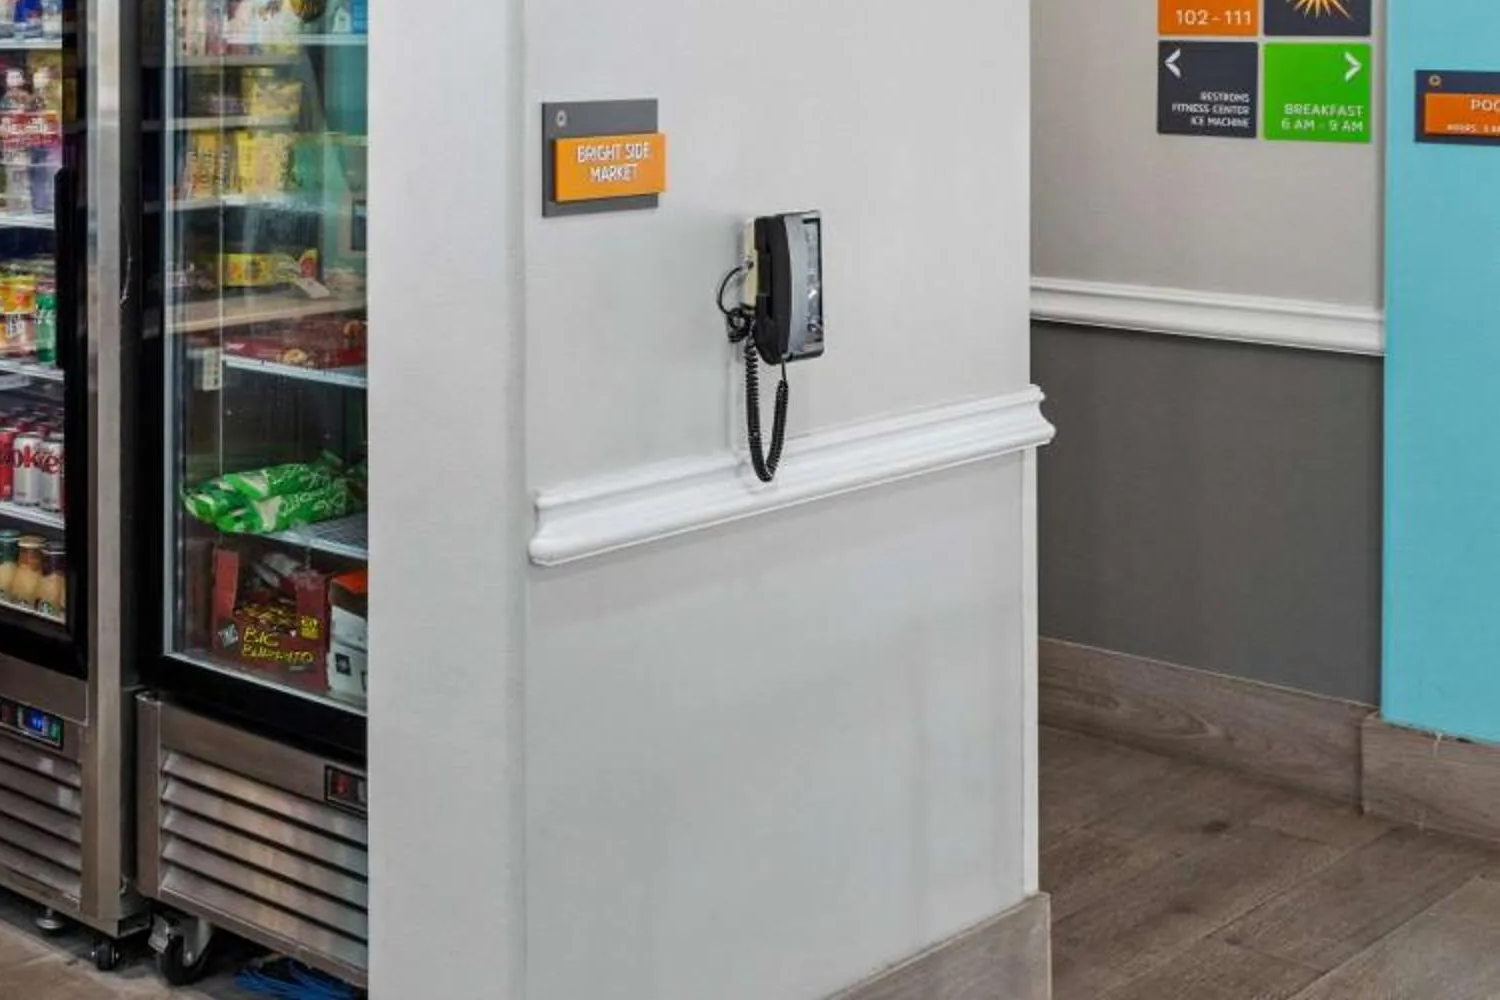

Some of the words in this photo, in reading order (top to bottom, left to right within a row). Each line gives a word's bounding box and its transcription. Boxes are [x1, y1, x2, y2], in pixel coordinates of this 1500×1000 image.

[1171, 103, 1211, 113] FITNESS
[1283, 104, 1364, 117] BREAKFAST
[1281, 120, 1290, 131] 6
[1294, 120, 1315, 131] AM
[1341, 120, 1364, 132] AM
[577, 144, 620, 163] BRIGHT
[626, 142, 649, 160] SIDE
[590, 164, 637, 182] MARKET
